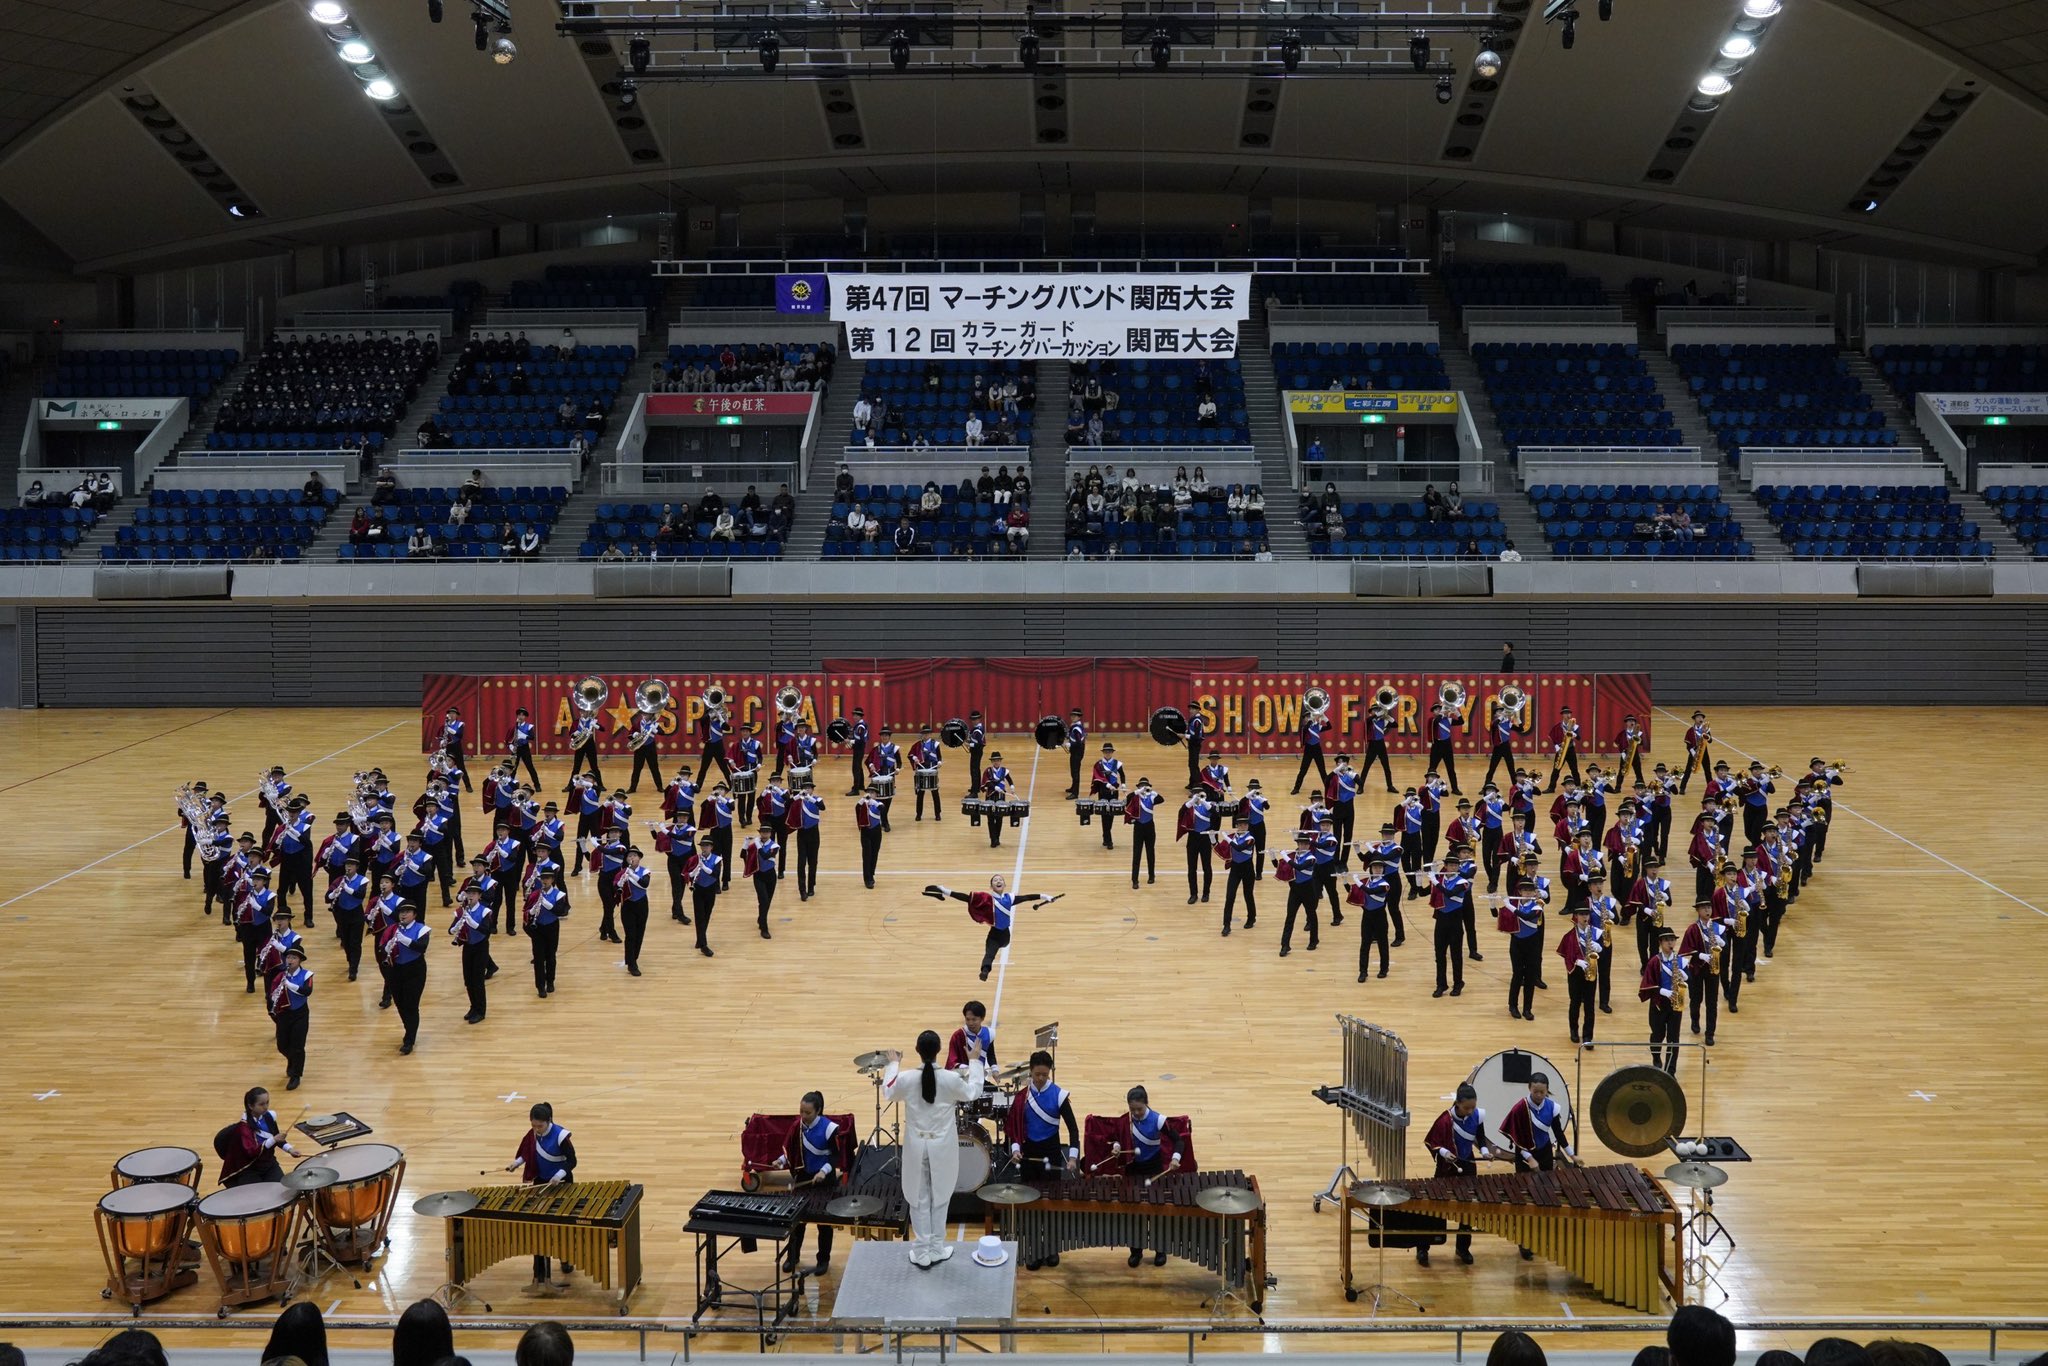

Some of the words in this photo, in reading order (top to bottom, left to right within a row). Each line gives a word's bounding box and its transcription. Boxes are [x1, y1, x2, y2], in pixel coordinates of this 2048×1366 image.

[845, 284, 930, 312] 第47回
[938, 284, 1126, 312] マーチングバンド
[1130, 284, 1236, 311] 関西大会
[962, 321, 1076, 339] カラーガード
[1125, 327, 1235, 353] 関西大会
[965, 338, 1122, 358] マーチングパーカッション
[708, 398, 766, 412] 午後の紅茶
[1289, 394, 1343, 404] PHOTO
[1399, 394, 1455, 405] STUDIO
[1197, 693, 1304, 734] SHOW
[1341, 694, 1419, 734] FR
